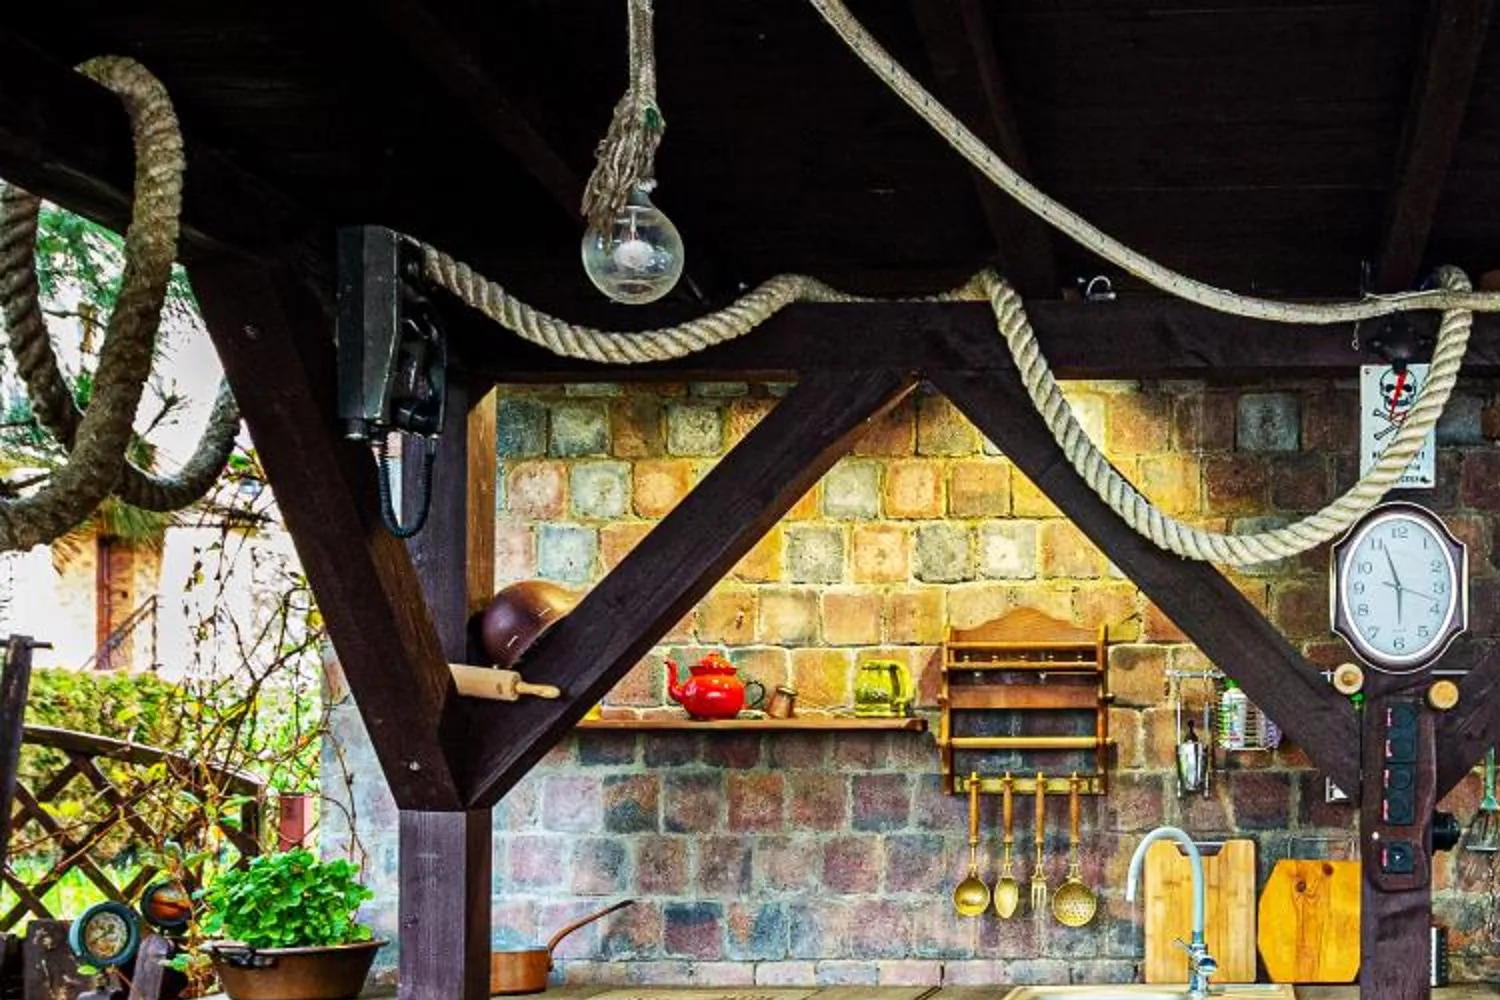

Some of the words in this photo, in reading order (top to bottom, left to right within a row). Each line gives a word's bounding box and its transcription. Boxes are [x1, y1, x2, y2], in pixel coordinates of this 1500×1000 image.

[1391, 526, 1408, 539] 12
[1372, 537, 1383, 551] 11
[1358, 562, 1373, 575] 10
[1431, 560, 1442, 573] 2
[1354, 582, 1365, 595] 9
[1433, 582, 1444, 593] 3
[1358, 604, 1369, 617] 8
[1430, 603, 1440, 614] 4
[1368, 626, 1379, 640] 7
[1418, 625, 1429, 637] 5
[1393, 637, 1405, 650] 6
